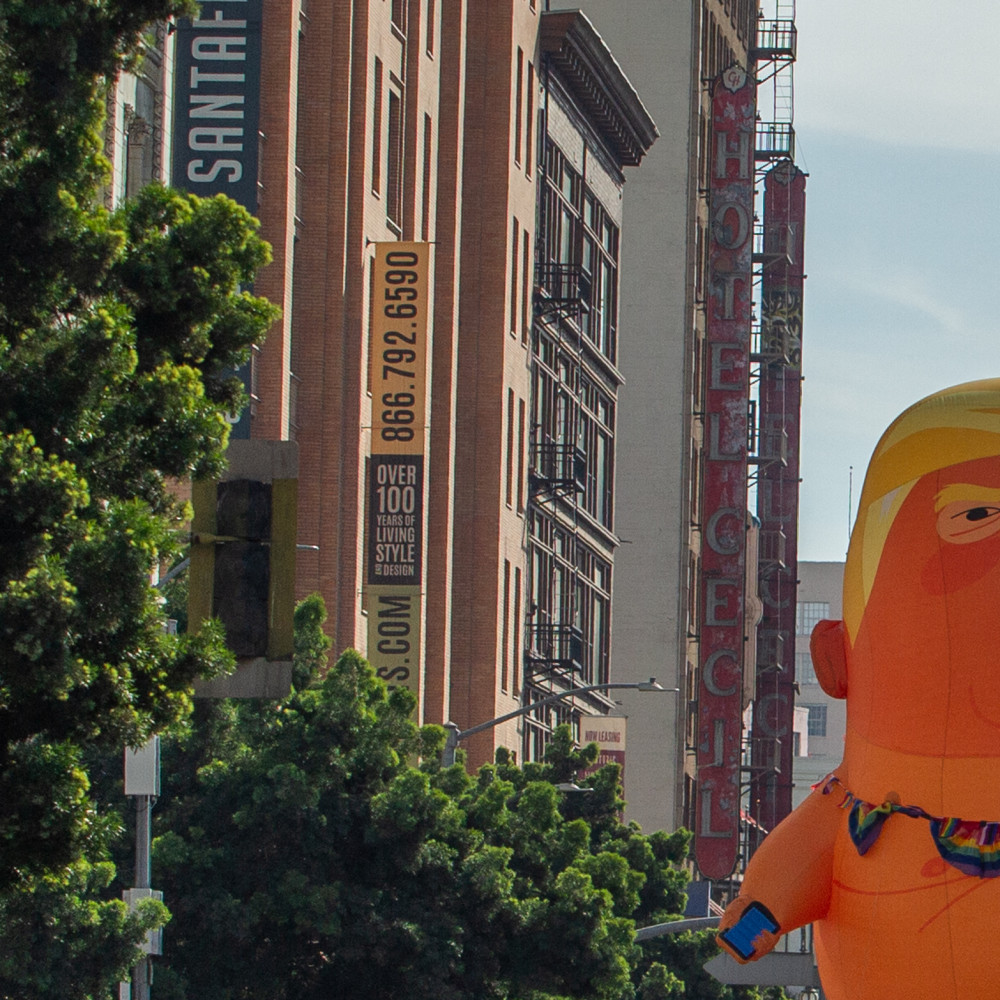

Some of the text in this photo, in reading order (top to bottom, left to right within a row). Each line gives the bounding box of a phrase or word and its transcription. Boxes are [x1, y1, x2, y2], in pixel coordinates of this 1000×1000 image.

[709, 130, 750, 461] HOTEL
[381, 251, 418, 442] 866.792.6590
[377, 464, 416, 485] OVER
[376, 486, 415, 513] 100
[376, 514, 416, 526] YEARS OF
[376, 527, 415, 543] LIVING
[375, 543, 415, 563] STYLE
[383, 564, 414, 576] DESIGN
[700, 507, 741, 838] CECIL
